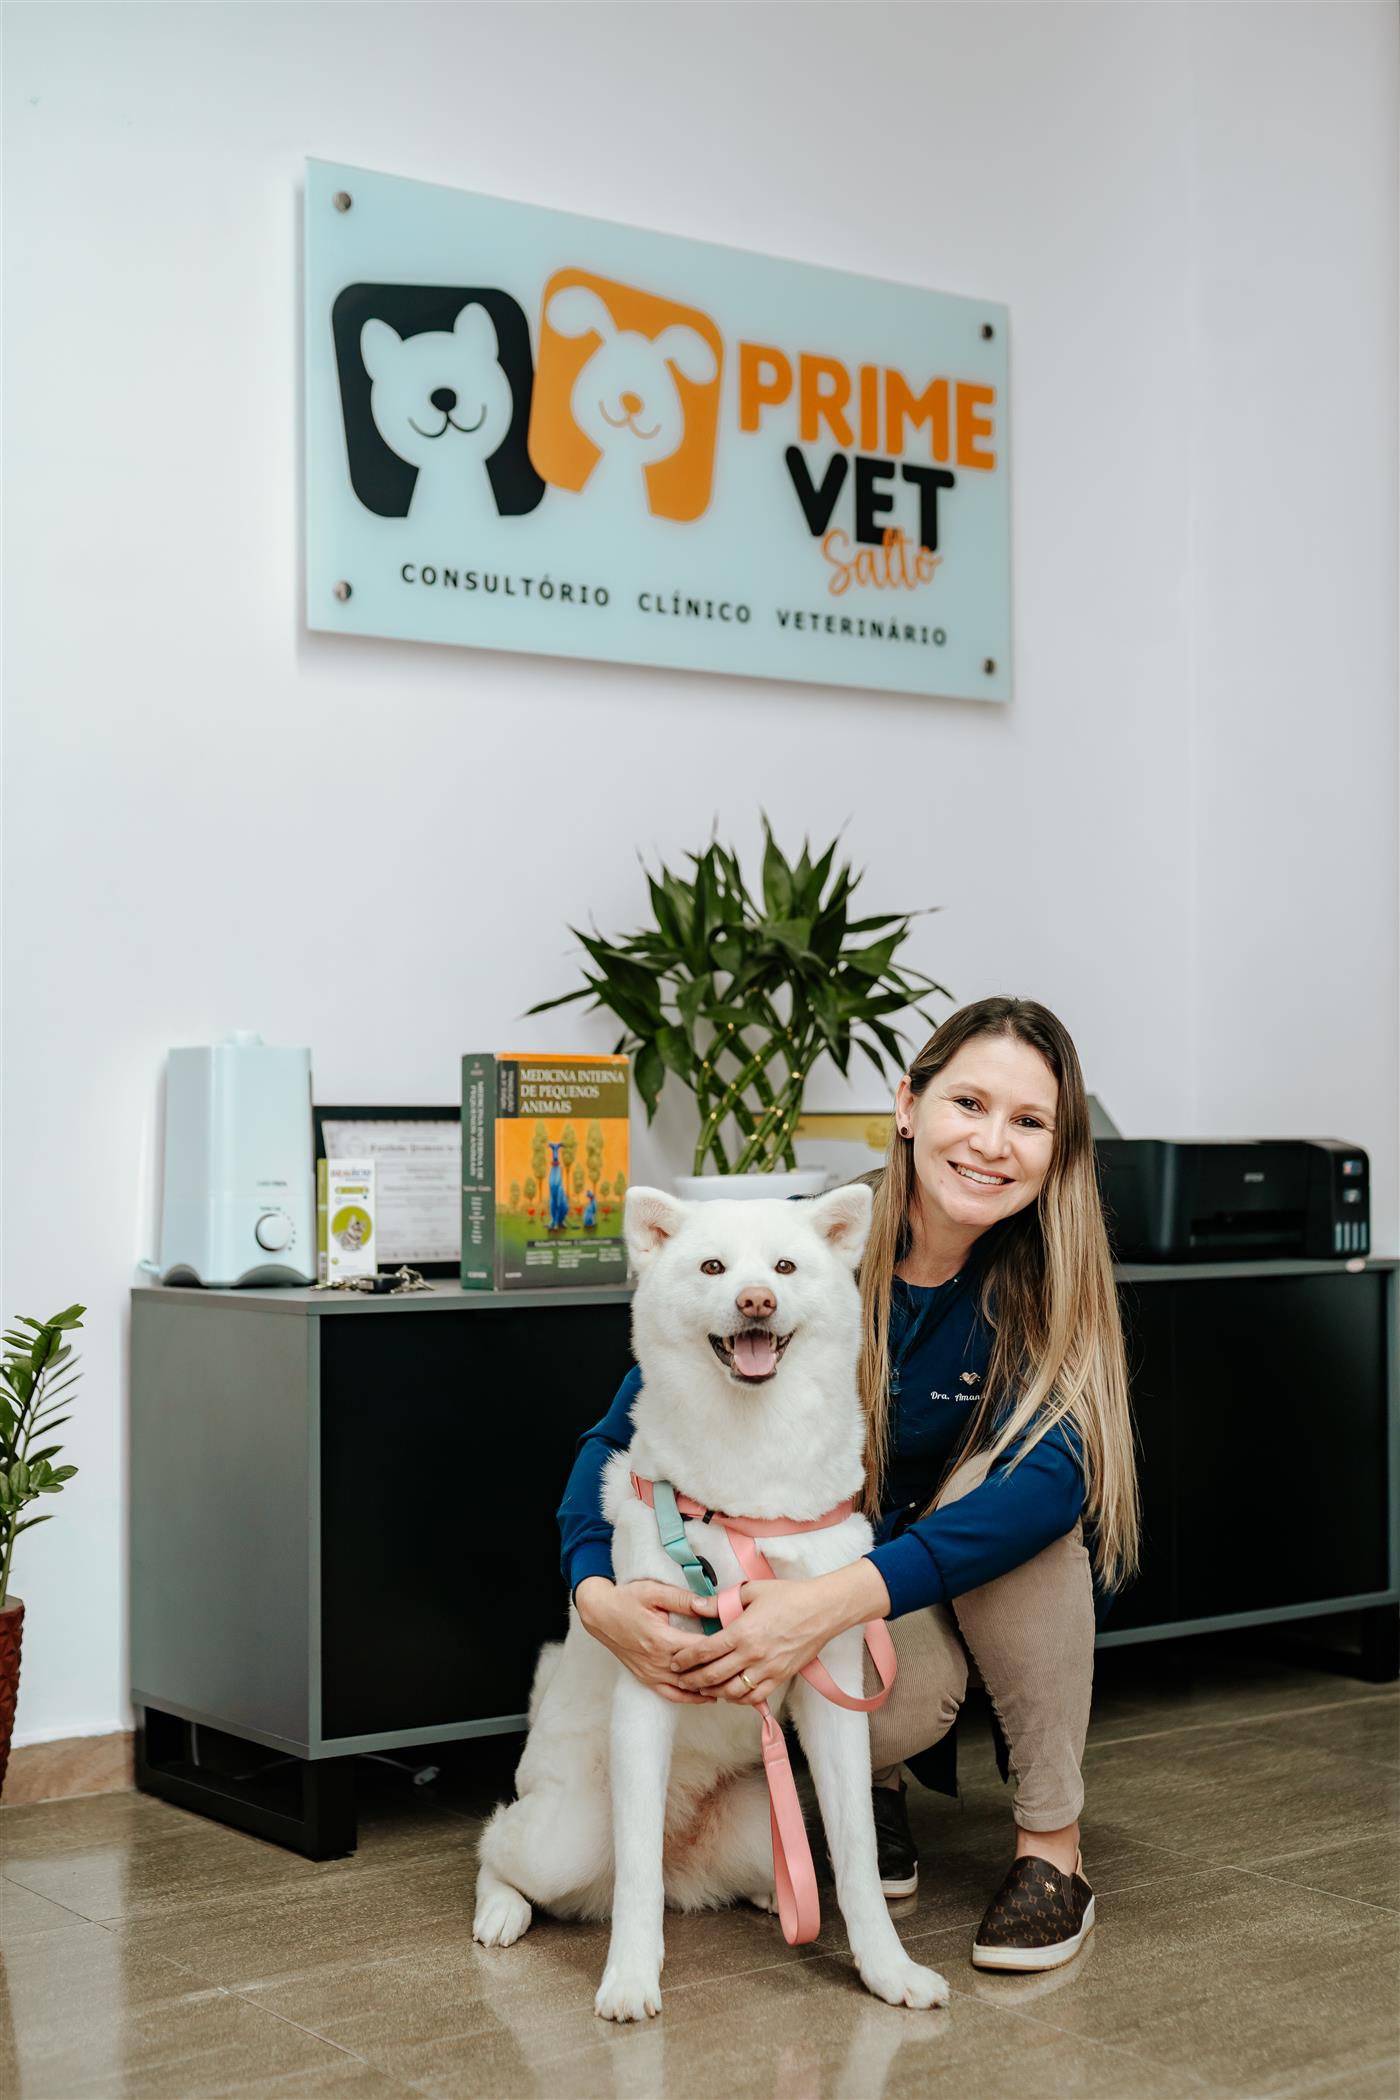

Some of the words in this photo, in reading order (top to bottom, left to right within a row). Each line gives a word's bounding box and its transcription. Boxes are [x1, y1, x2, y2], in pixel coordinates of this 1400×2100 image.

[738, 341, 996, 471] PRIME
[785, 446, 955, 552] VET
[821, 527, 943, 596] Salto
[401, 563, 610, 607] CONSULTÓRIO
[638, 591, 751, 624] CLÍNICO
[776, 608, 947, 648] VETERINÁRIO
[520, 1068, 576, 1082] MEDICINA
[577, 1070, 625, 1084] INTERNA
[520, 1084, 537, 1097] DE
[538, 1085, 600, 1100] PEQUENOS
[520, 1101, 572, 1114] ANIMAIS
[930, 1391, 950, 1400] Dra.
[954, 1392, 981, 1402] Aman
